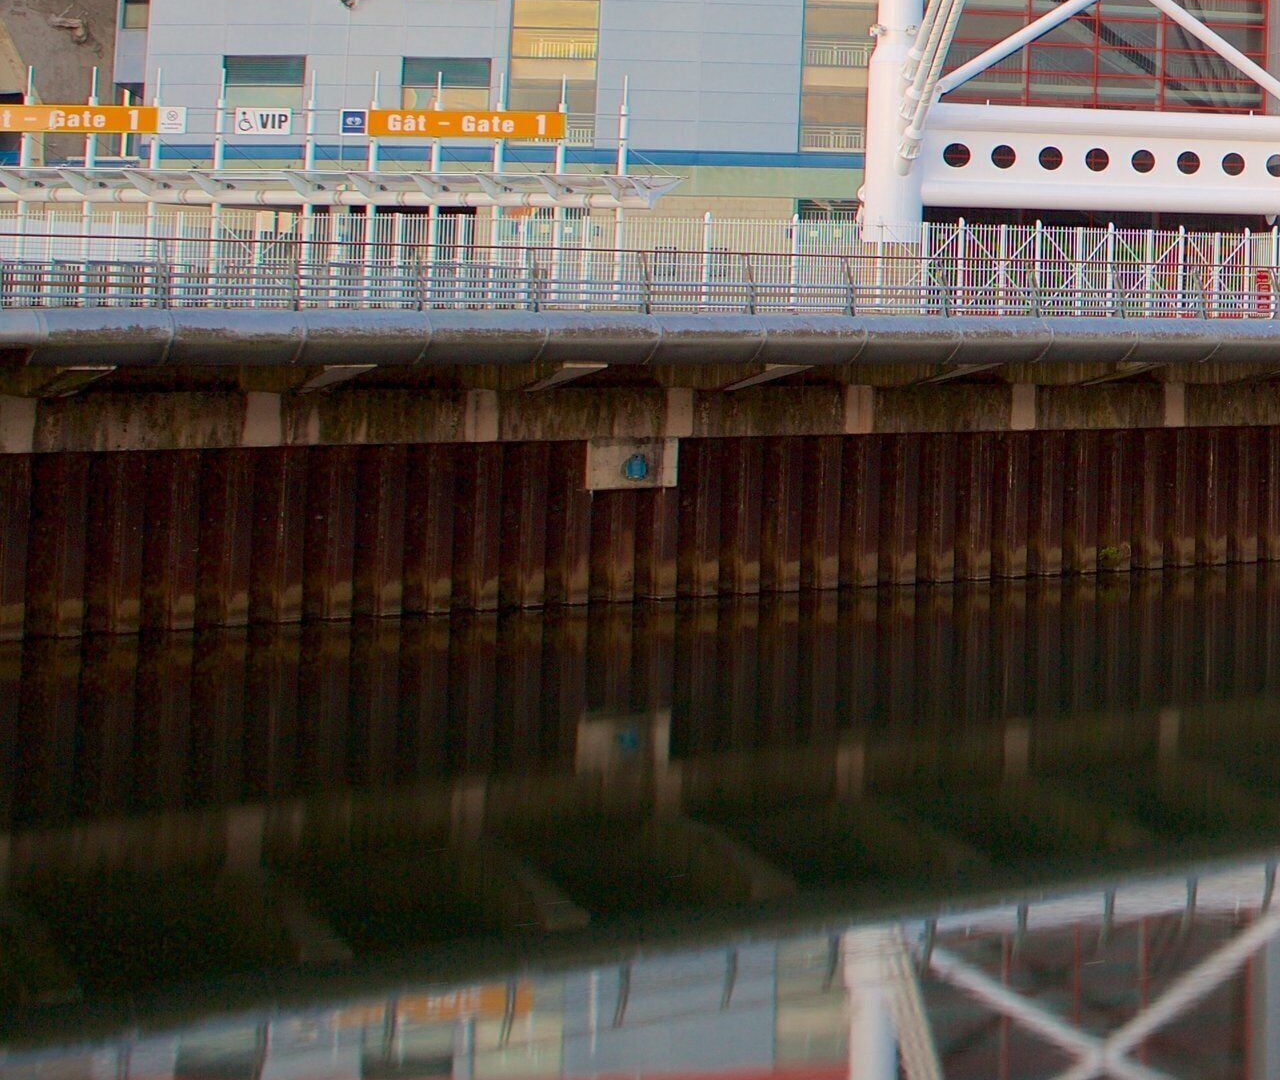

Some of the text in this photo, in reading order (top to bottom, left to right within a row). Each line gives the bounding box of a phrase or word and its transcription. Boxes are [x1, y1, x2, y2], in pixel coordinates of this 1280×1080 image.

[50, 109, 107, 129] Gate
[128, 109, 140, 131] 1
[259, 112, 289, 130] VIP
[387, 114, 427, 132] Gât
[461, 115, 515, 133] Gate
[535, 114, 546, 136] 1
